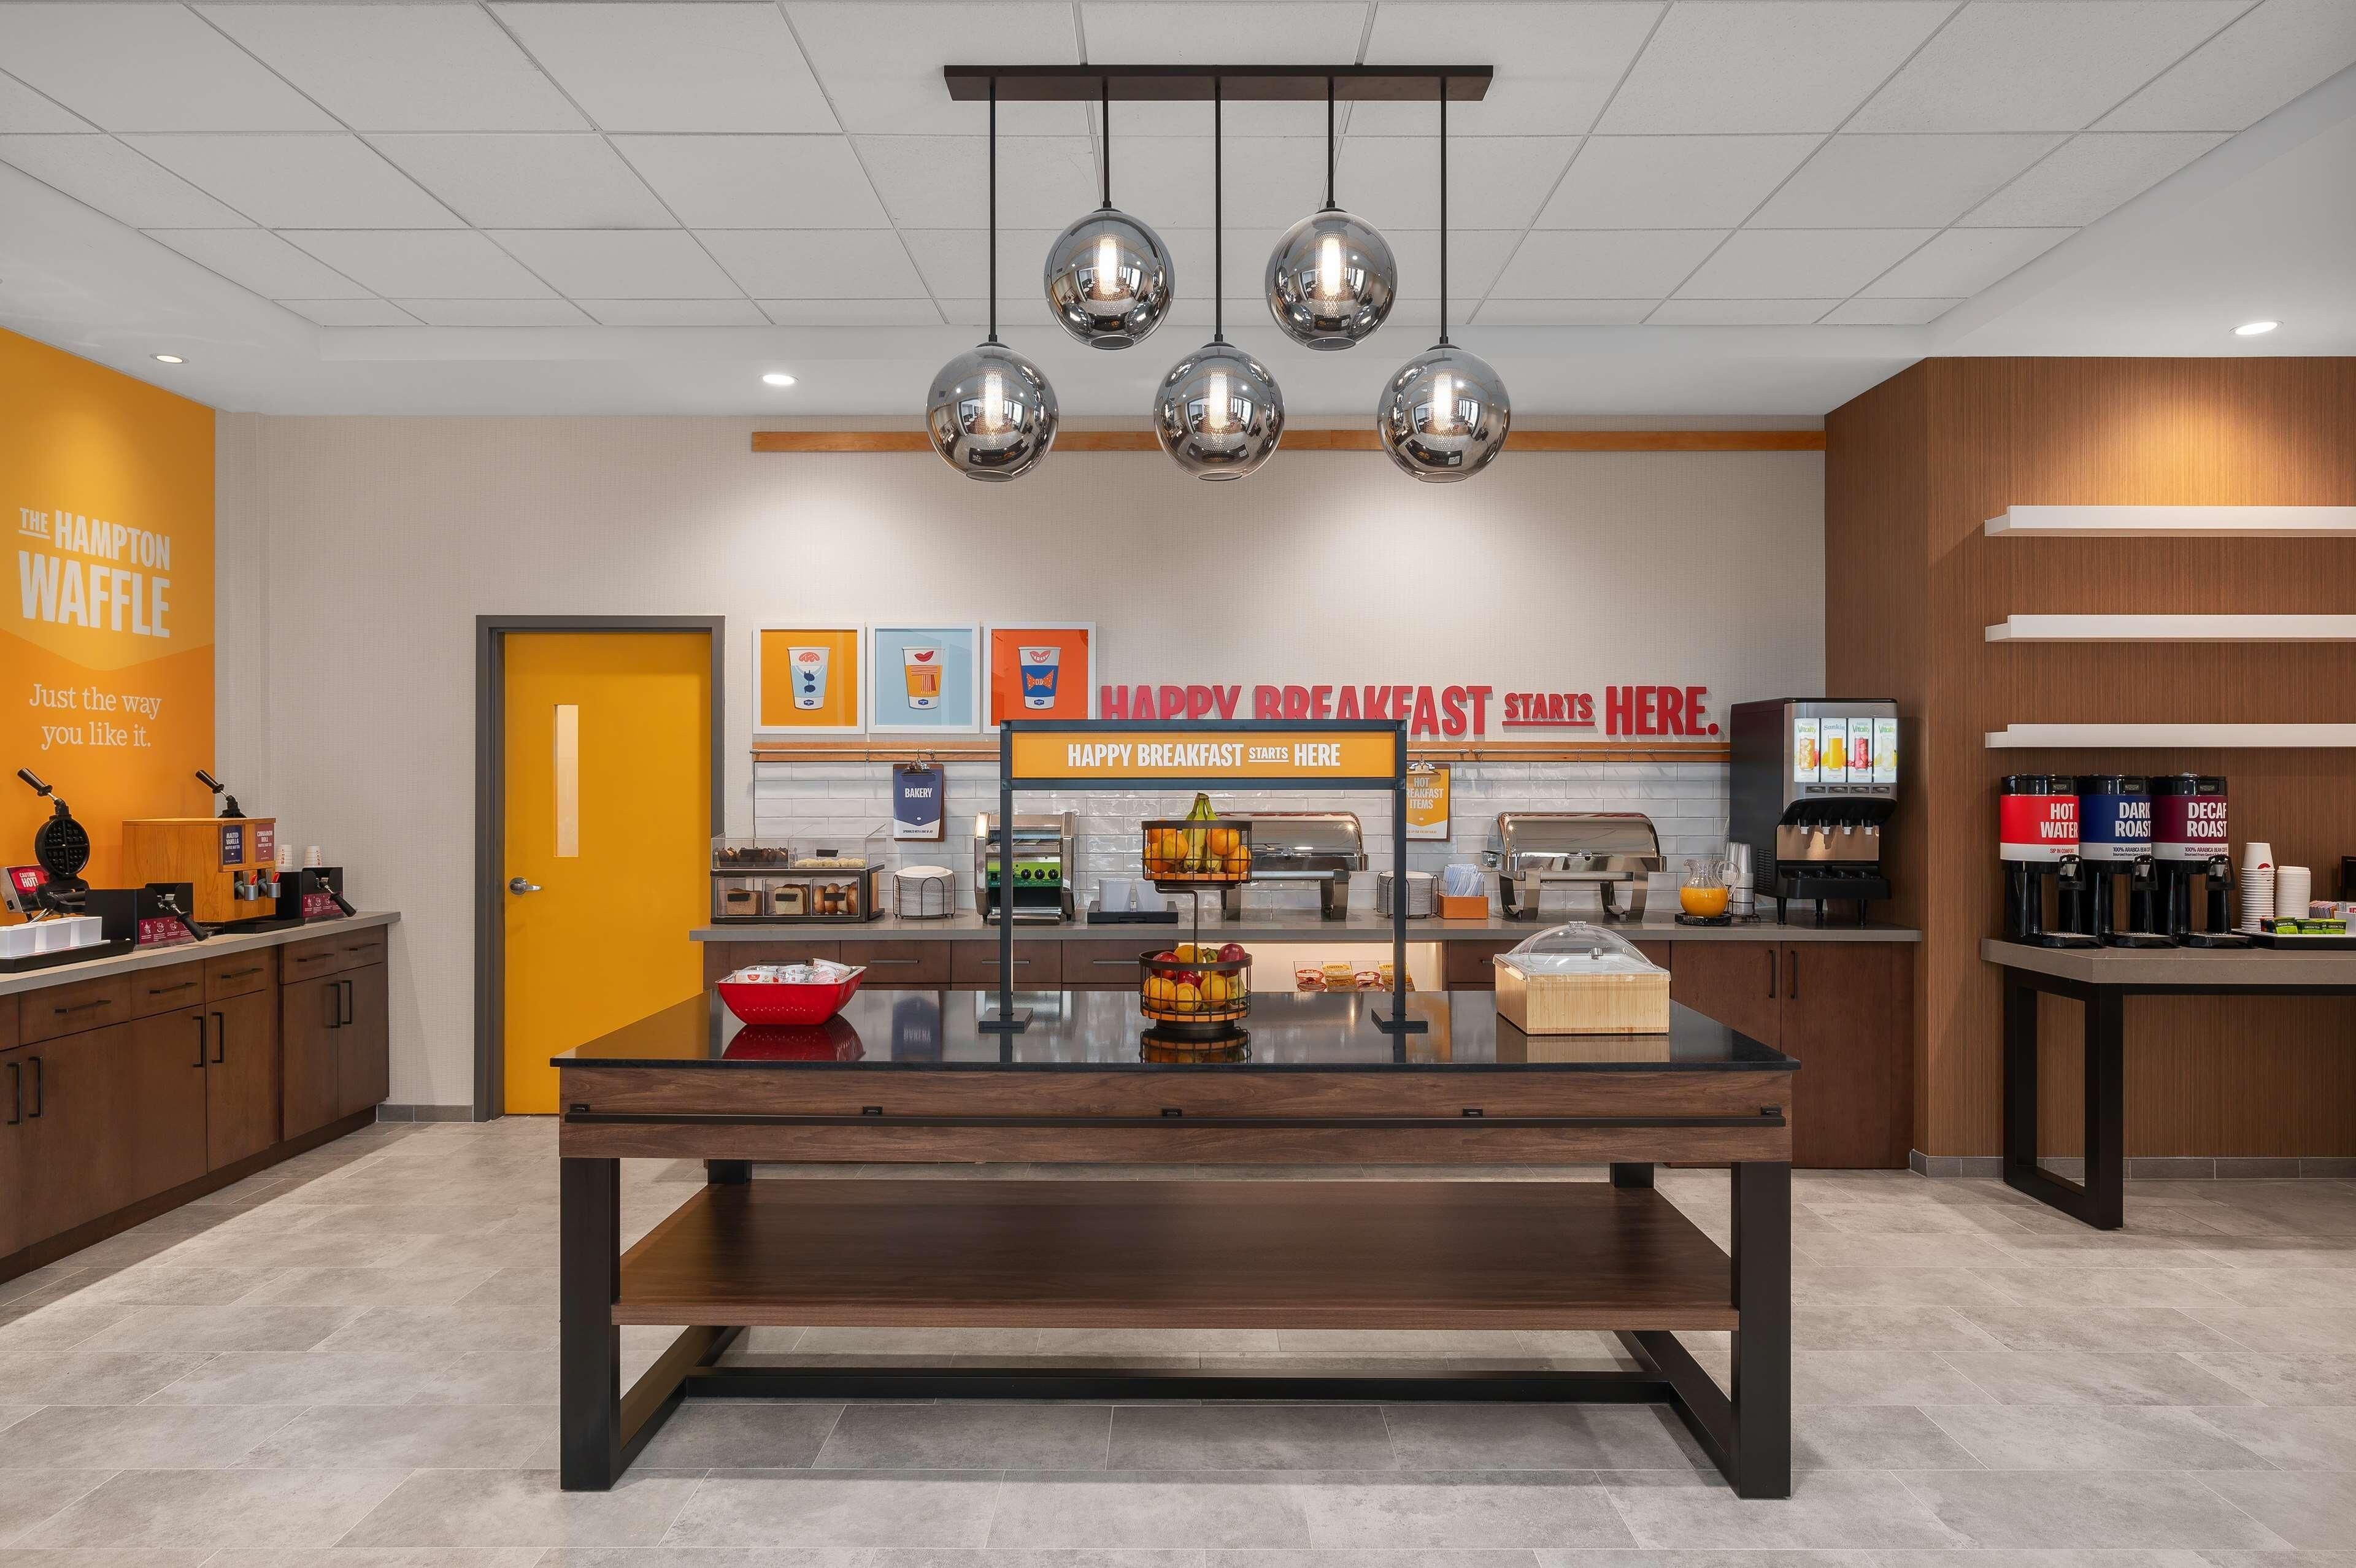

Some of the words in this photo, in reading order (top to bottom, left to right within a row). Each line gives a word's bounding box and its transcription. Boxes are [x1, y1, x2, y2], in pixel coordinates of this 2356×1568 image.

[20, 507, 48, 533] THE
[55, 510, 171, 571] HAMPTON
[18, 550, 171, 638] WAFFLE
[29, 683, 76, 710] Just
[82, 686, 117, 710] the
[121, 694, 162, 720] way
[1253, 685, 1493, 736] BREAKFAST
[1504, 693, 1593, 720] STARTS
[1605, 686, 1719, 736] HERE.
[41, 725, 83, 750] you
[89, 721, 128, 746] like
[133, 724, 152, 747] it.
[1067, 743, 1133, 767] HAPPY
[1137, 743, 1244, 767] BREAKFAST
[1248, 747, 1288, 759] STARTS
[1294, 743, 1341, 767] HERE
[1414, 777, 1430, 788] HOT
[904, 788, 933, 798] BAKERY
[1410, 799, 1434, 810] ITEMS
[2050, 803, 2074, 820] HOT
[2119, 802, 2150, 819] DARK
[2188, 802, 2227, 819] DECAF
[2040, 821, 2079, 839] WATER
[2115, 820, 2151, 837] ROAST
[2187, 820, 2228, 837] ROAST
[21, 877, 39, 888] HOT!
